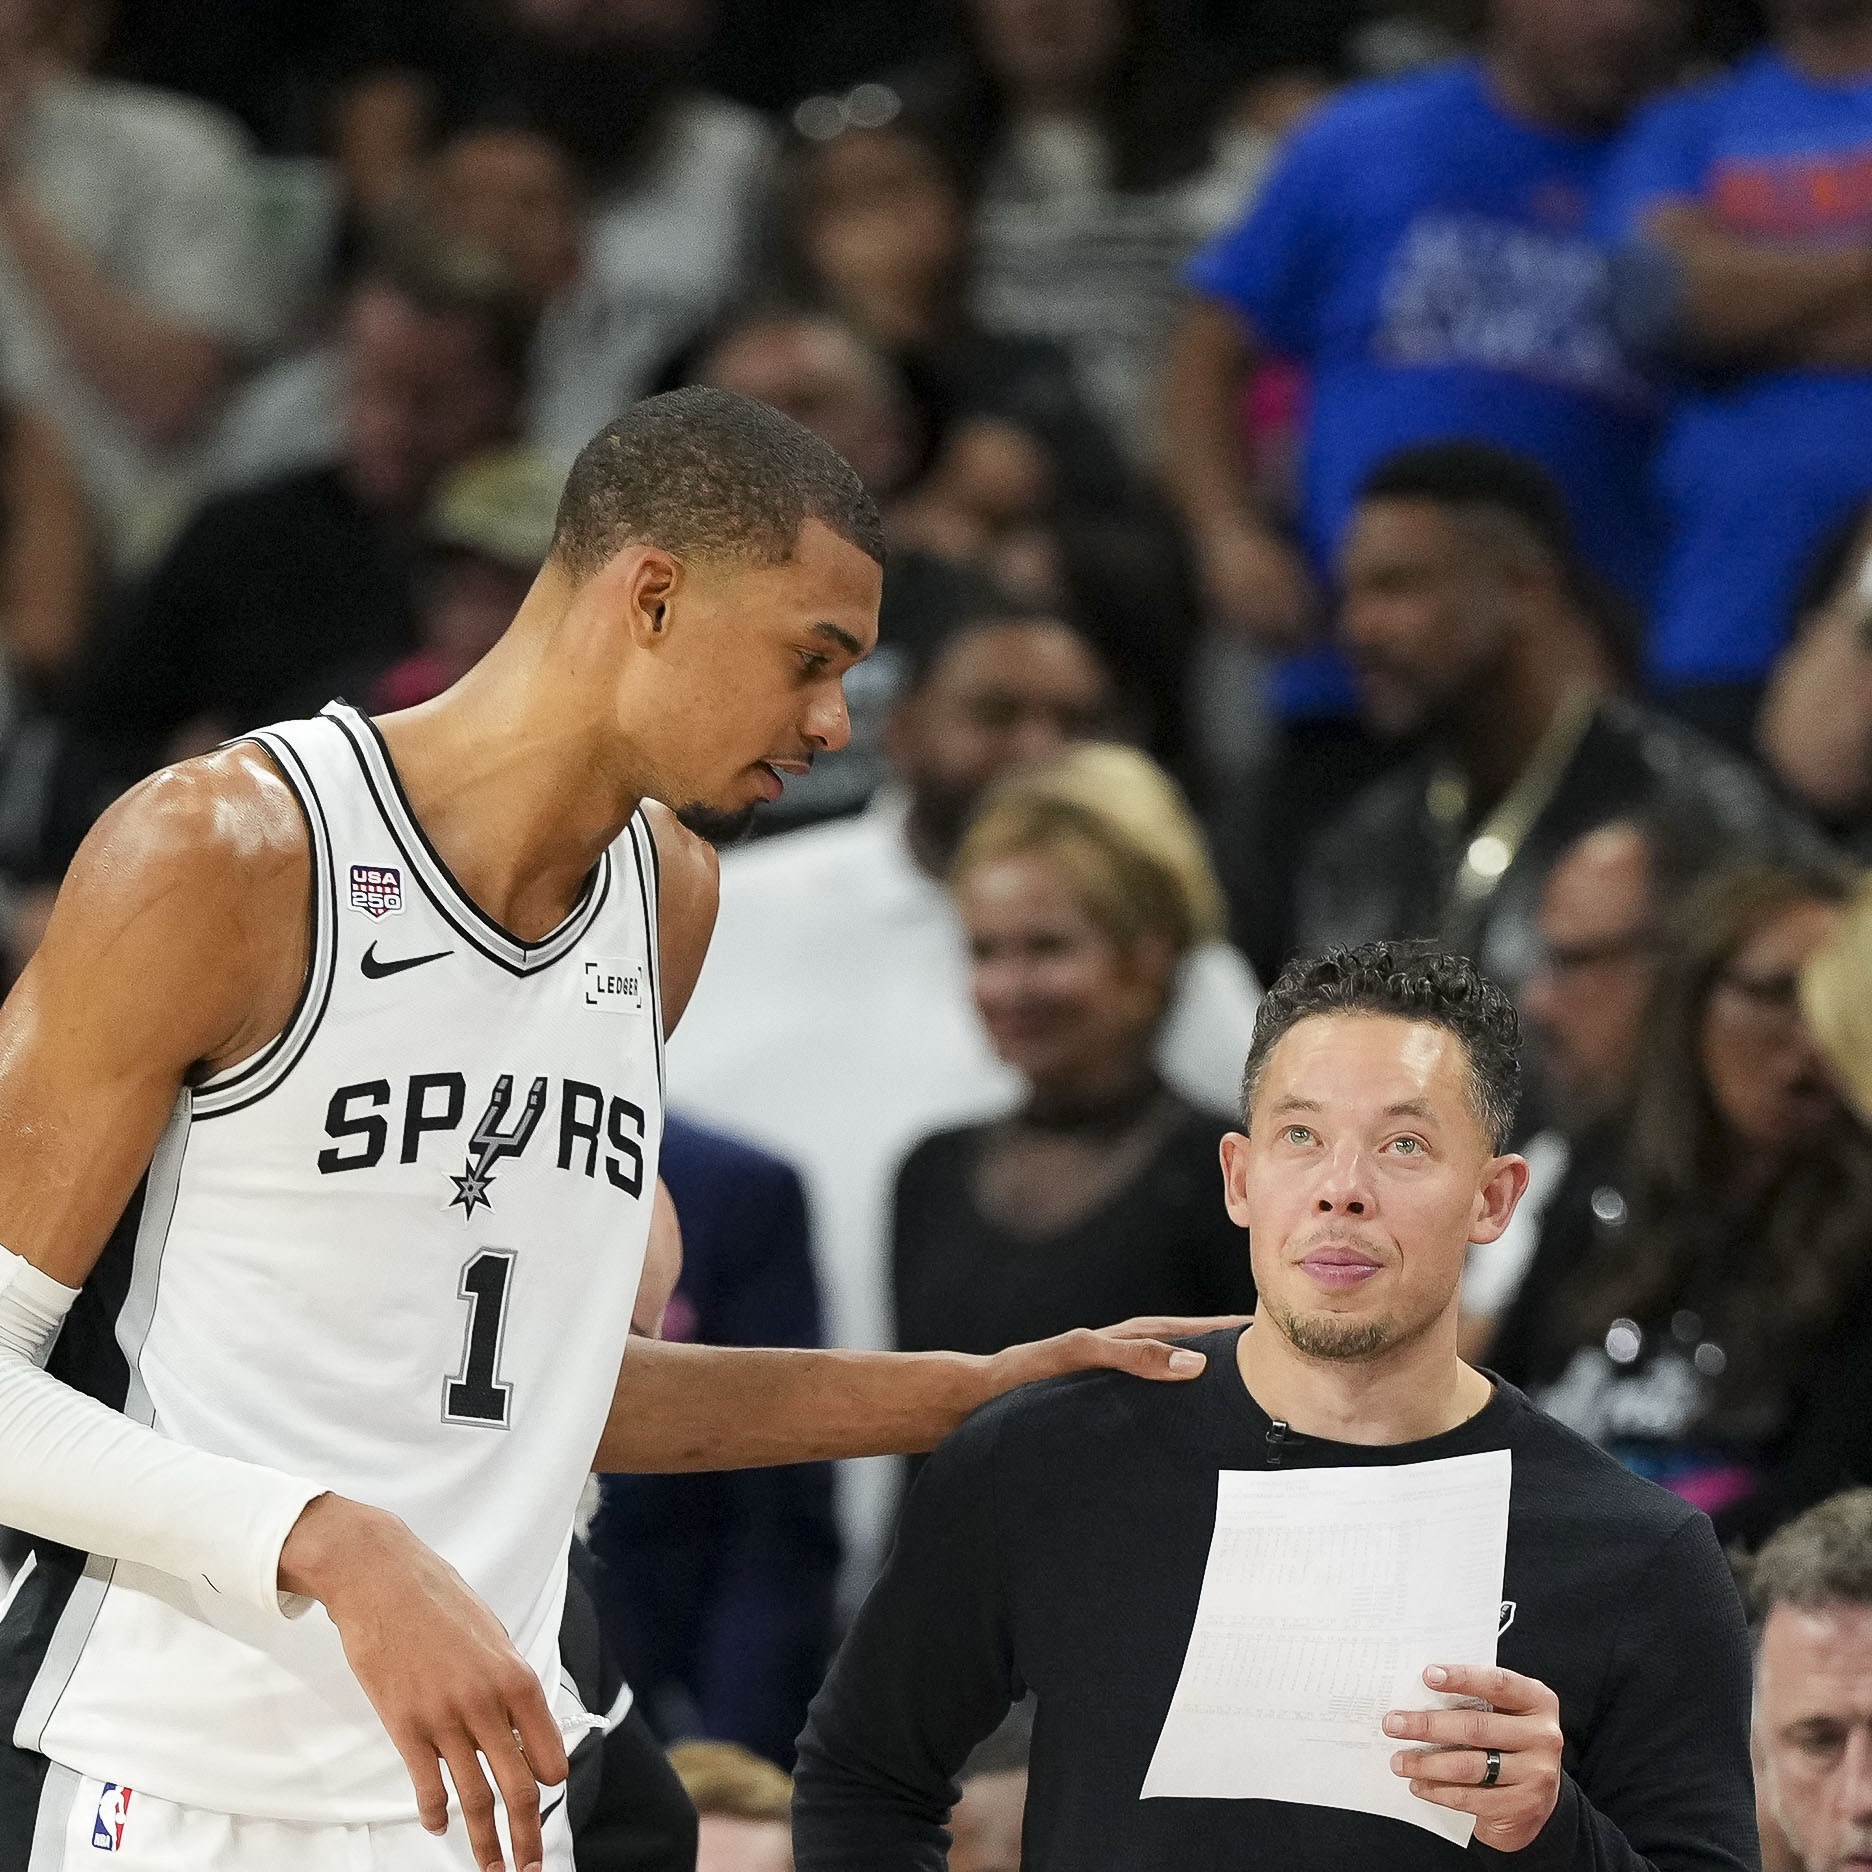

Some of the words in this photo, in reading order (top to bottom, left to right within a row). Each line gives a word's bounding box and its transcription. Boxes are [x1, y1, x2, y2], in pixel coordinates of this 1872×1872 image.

[352, 869, 398, 886] USA
[351, 891, 401, 910] 250
[597, 974, 639, 996] LEDGER
[317, 1071, 646, 1222] SPURS
[441, 1246, 518, 1431] 1
